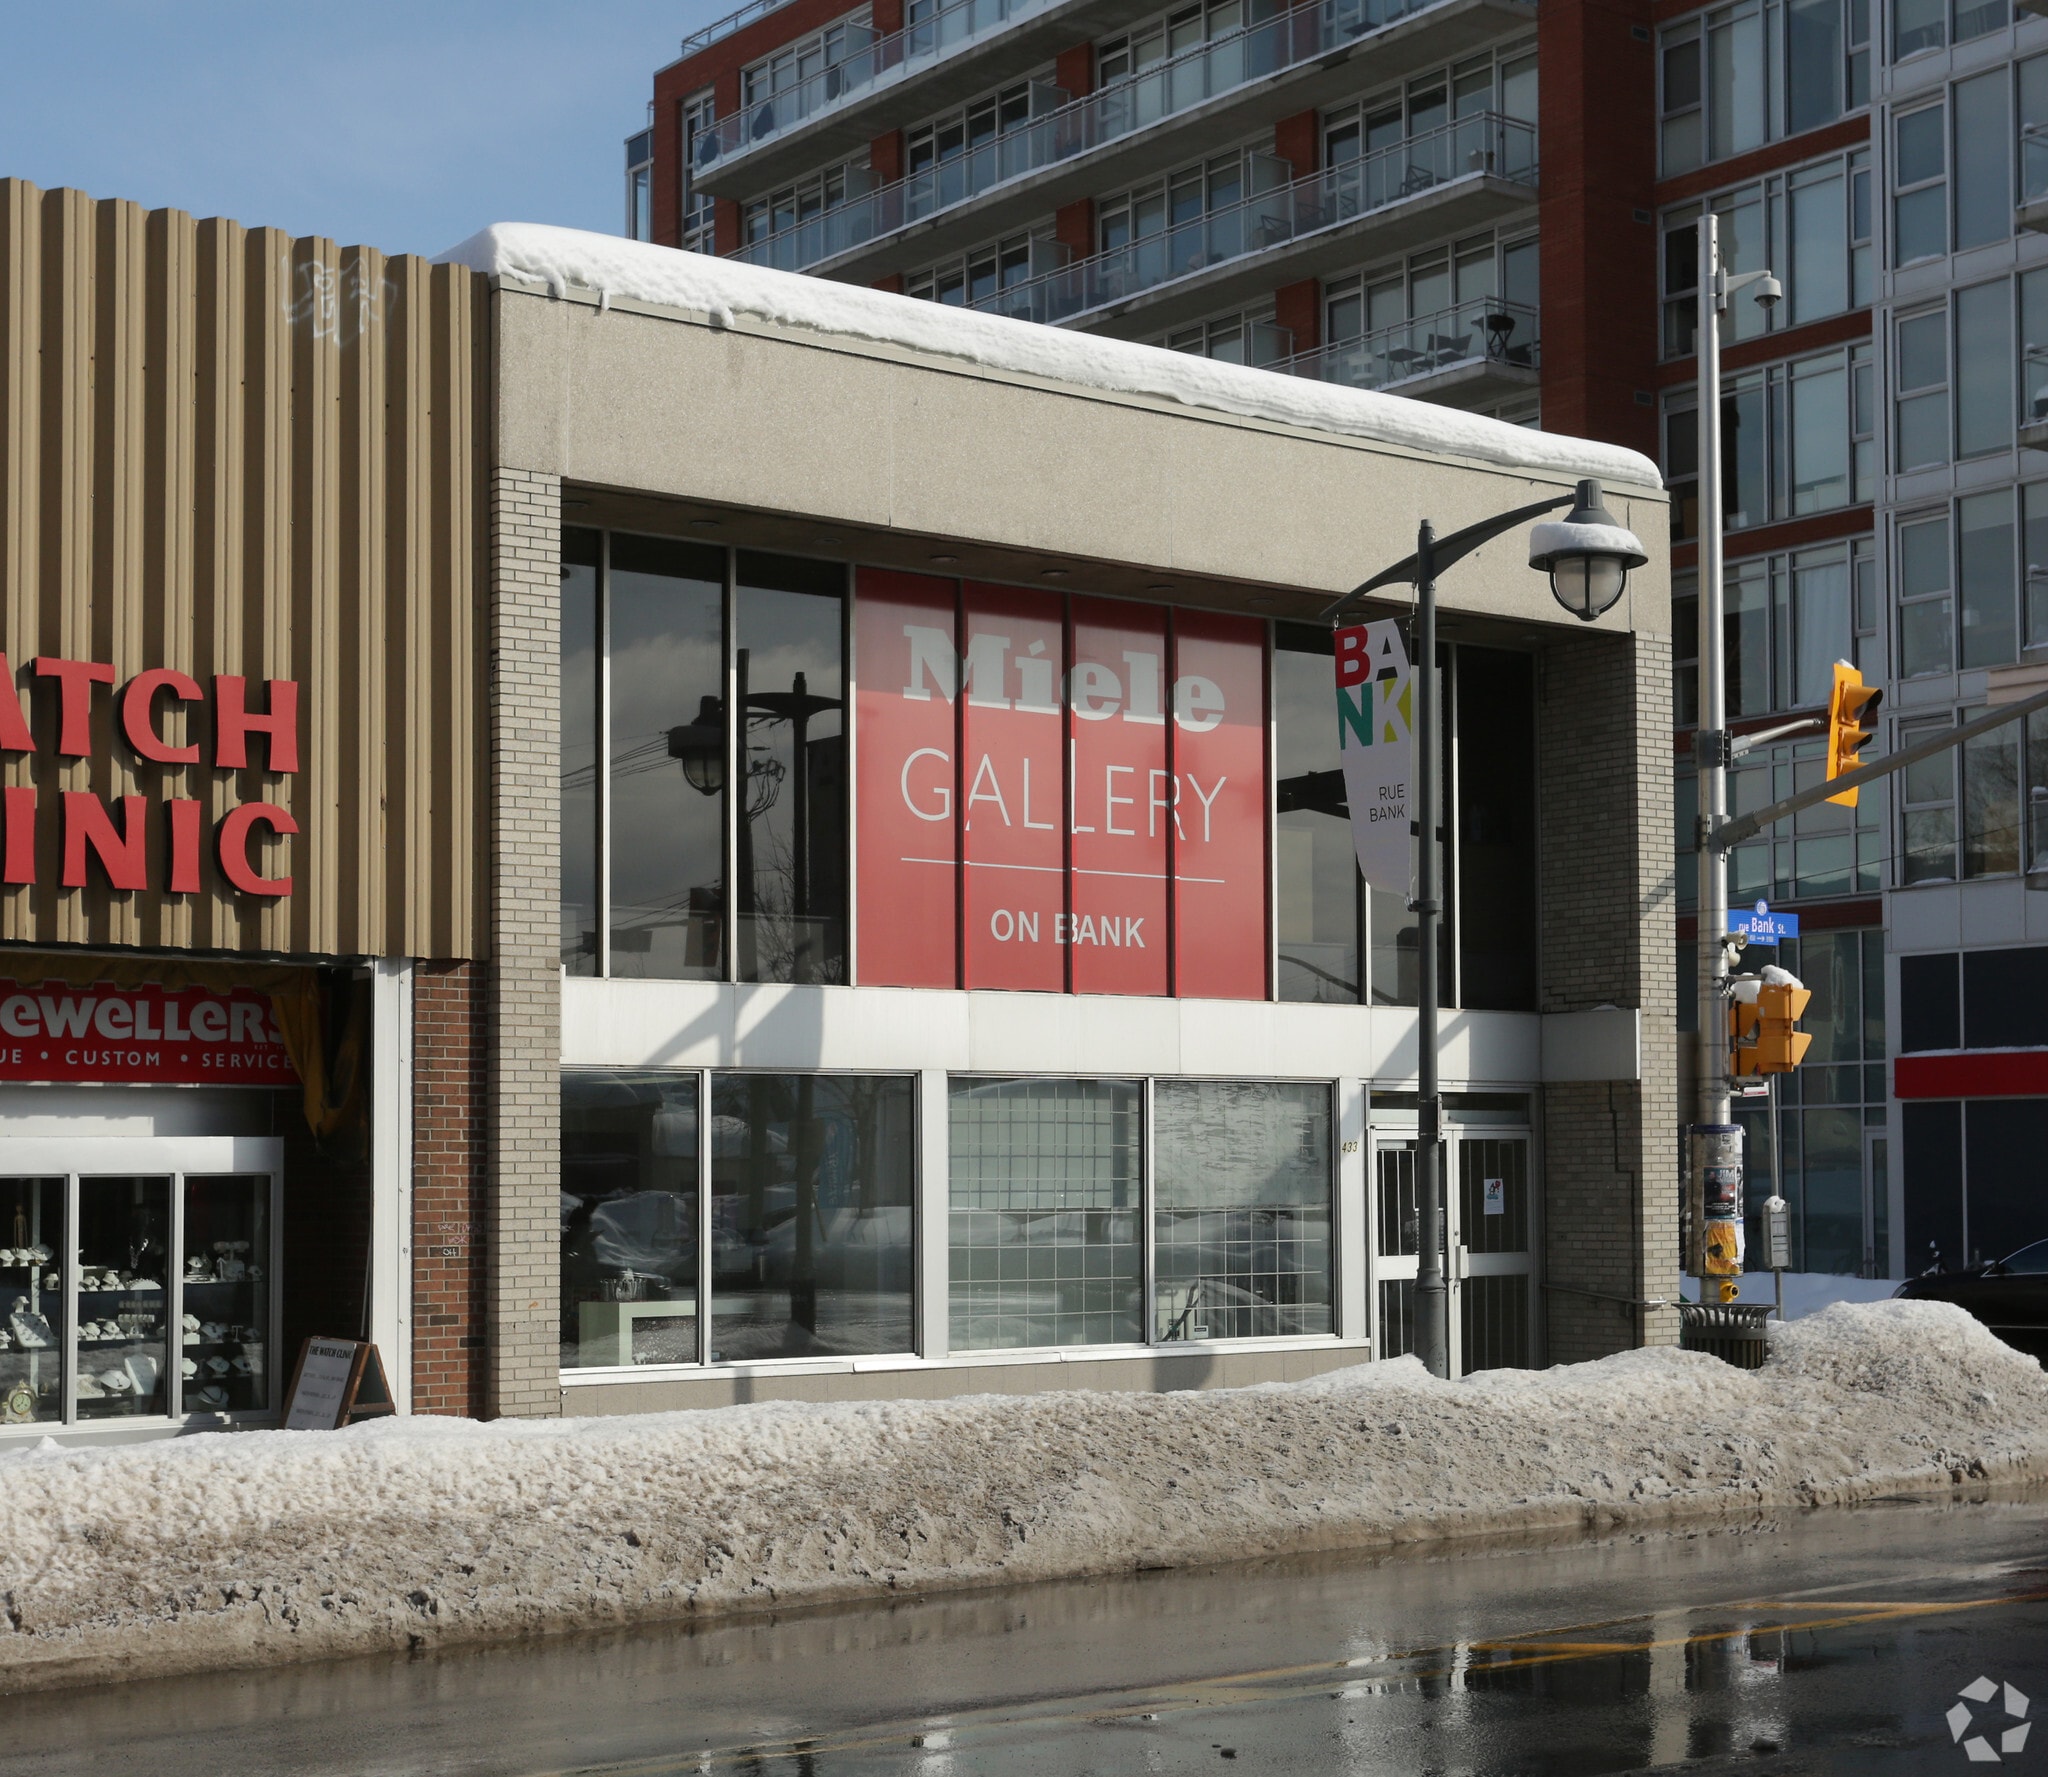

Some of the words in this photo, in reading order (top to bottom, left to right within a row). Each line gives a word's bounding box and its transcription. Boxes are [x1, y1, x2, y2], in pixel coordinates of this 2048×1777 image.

[903, 624, 1225, 732] Miele
[901, 739, 1227, 842] GALLERY
[1378, 783, 1405, 801] RUE
[1369, 804, 1405, 823] BANK
[3, 786, 299, 897] INIC
[990, 909, 1039, 943] ON
[1054, 912, 1145, 948] BANK
[1751, 916, 1775, 934] Bank
[65, 1049, 160, 1066] CUSTOM
[1341, 1141, 1358, 1153] 433
[309, 1345, 320, 1356] THE
[319, 1347, 337, 1358] WATCH
[336, 1348, 354, 1360] CLINIC
